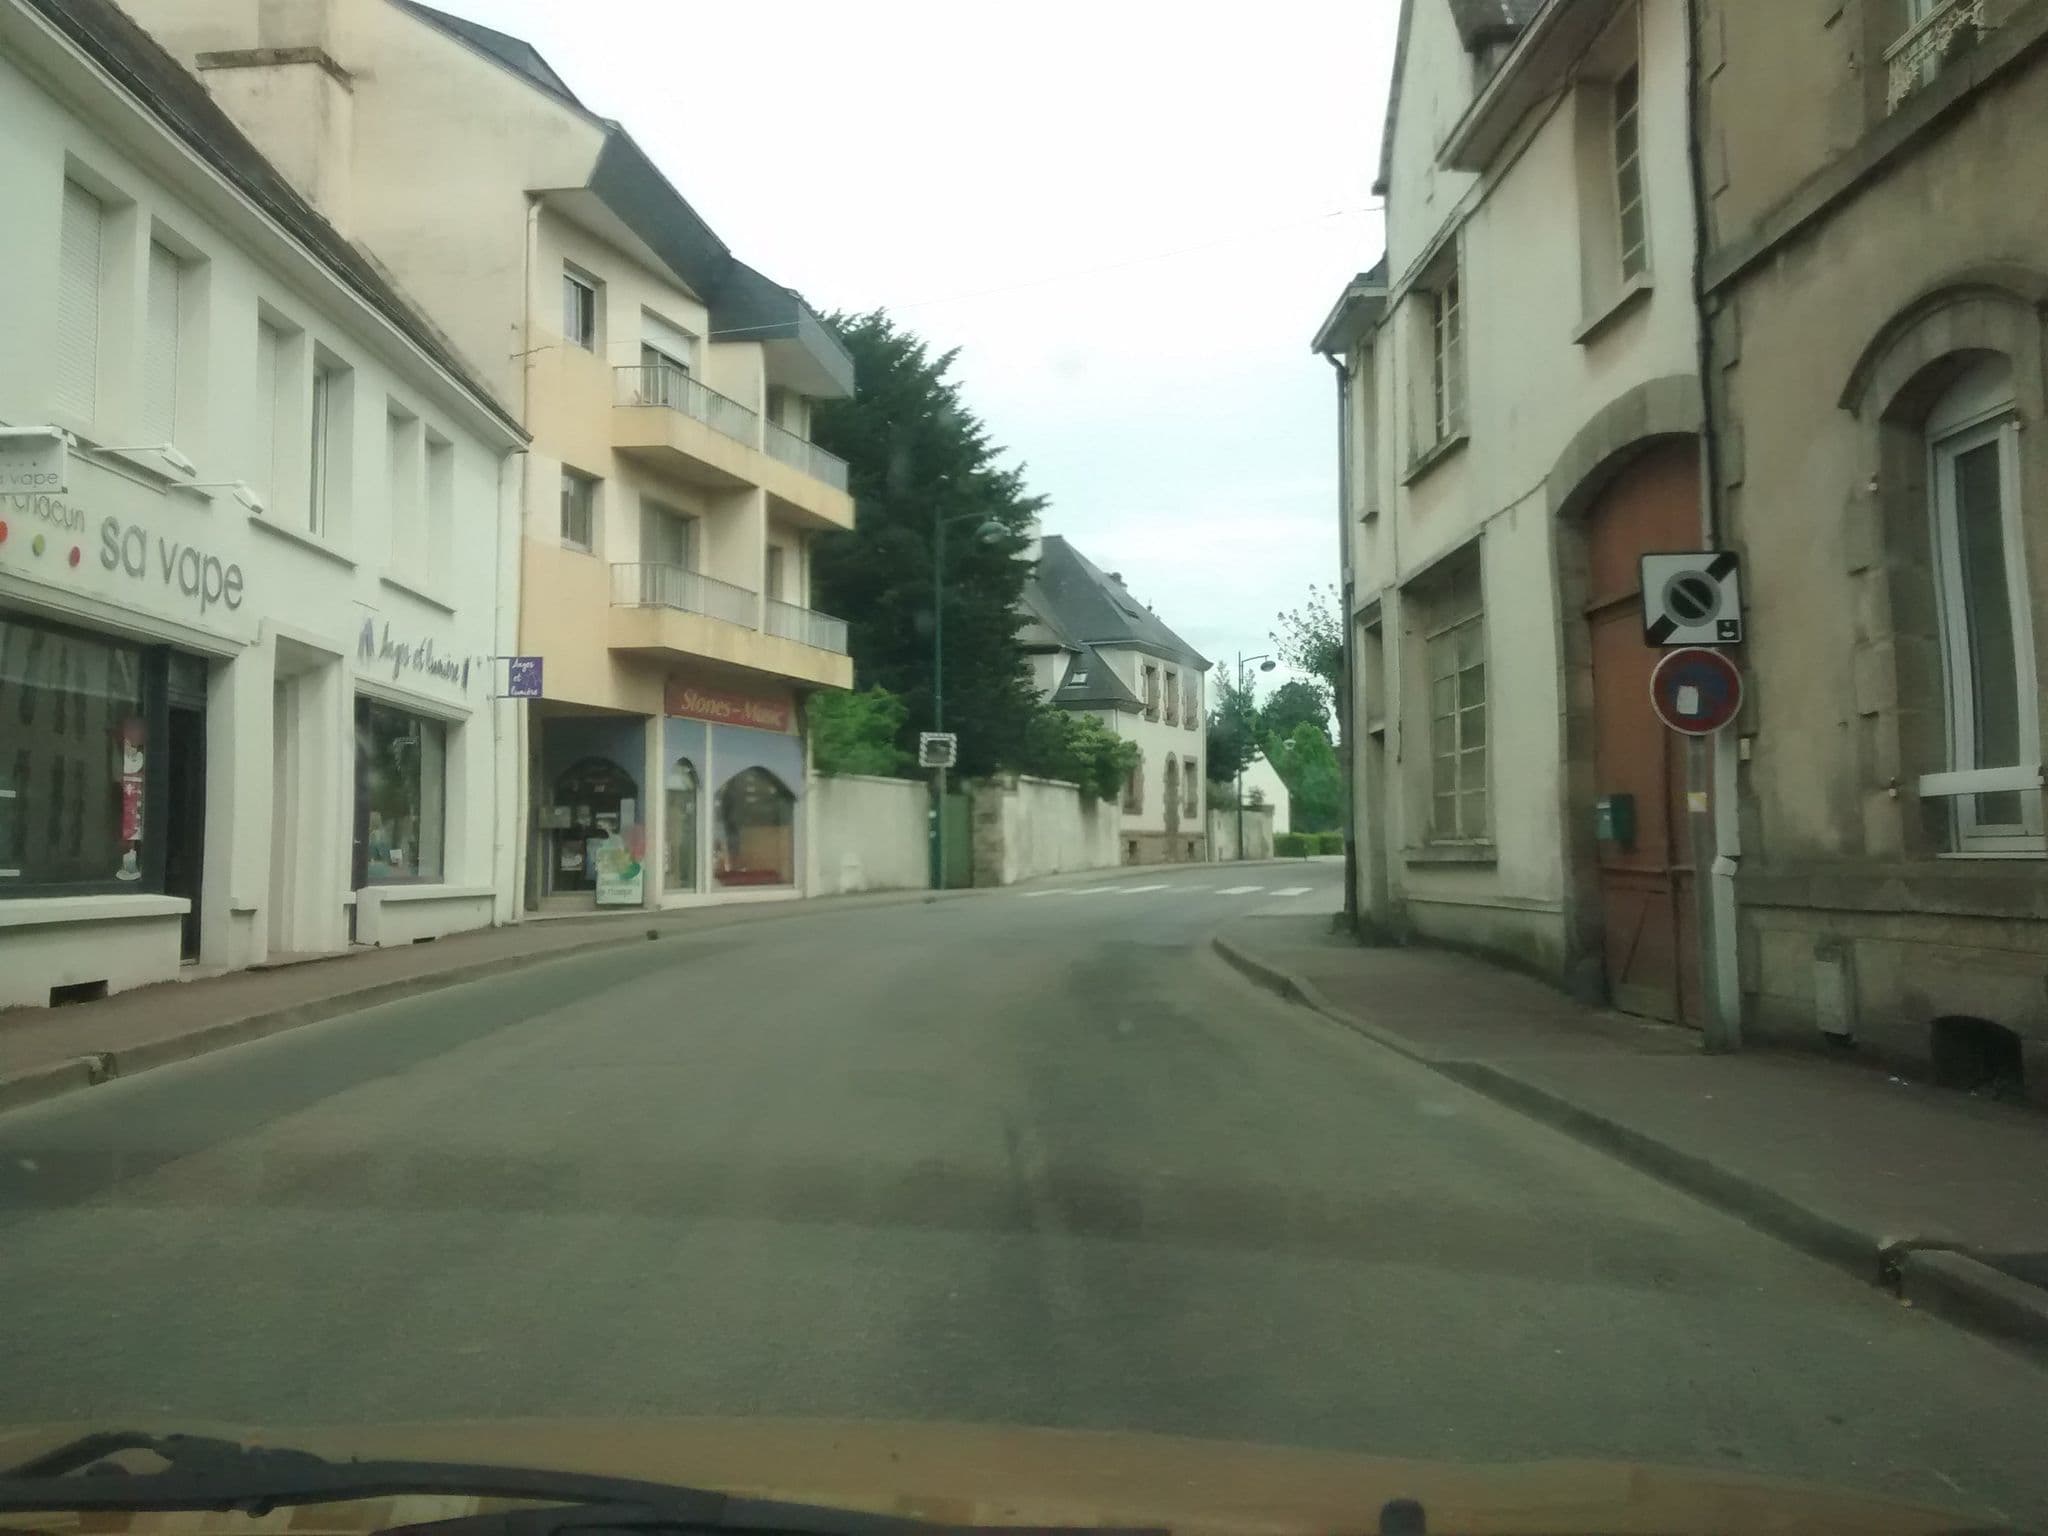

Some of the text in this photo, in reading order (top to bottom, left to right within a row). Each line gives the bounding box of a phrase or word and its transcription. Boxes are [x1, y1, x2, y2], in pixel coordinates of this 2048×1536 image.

[10, 471, 58, 489] vape
[100, 516, 244, 614] sa vape
